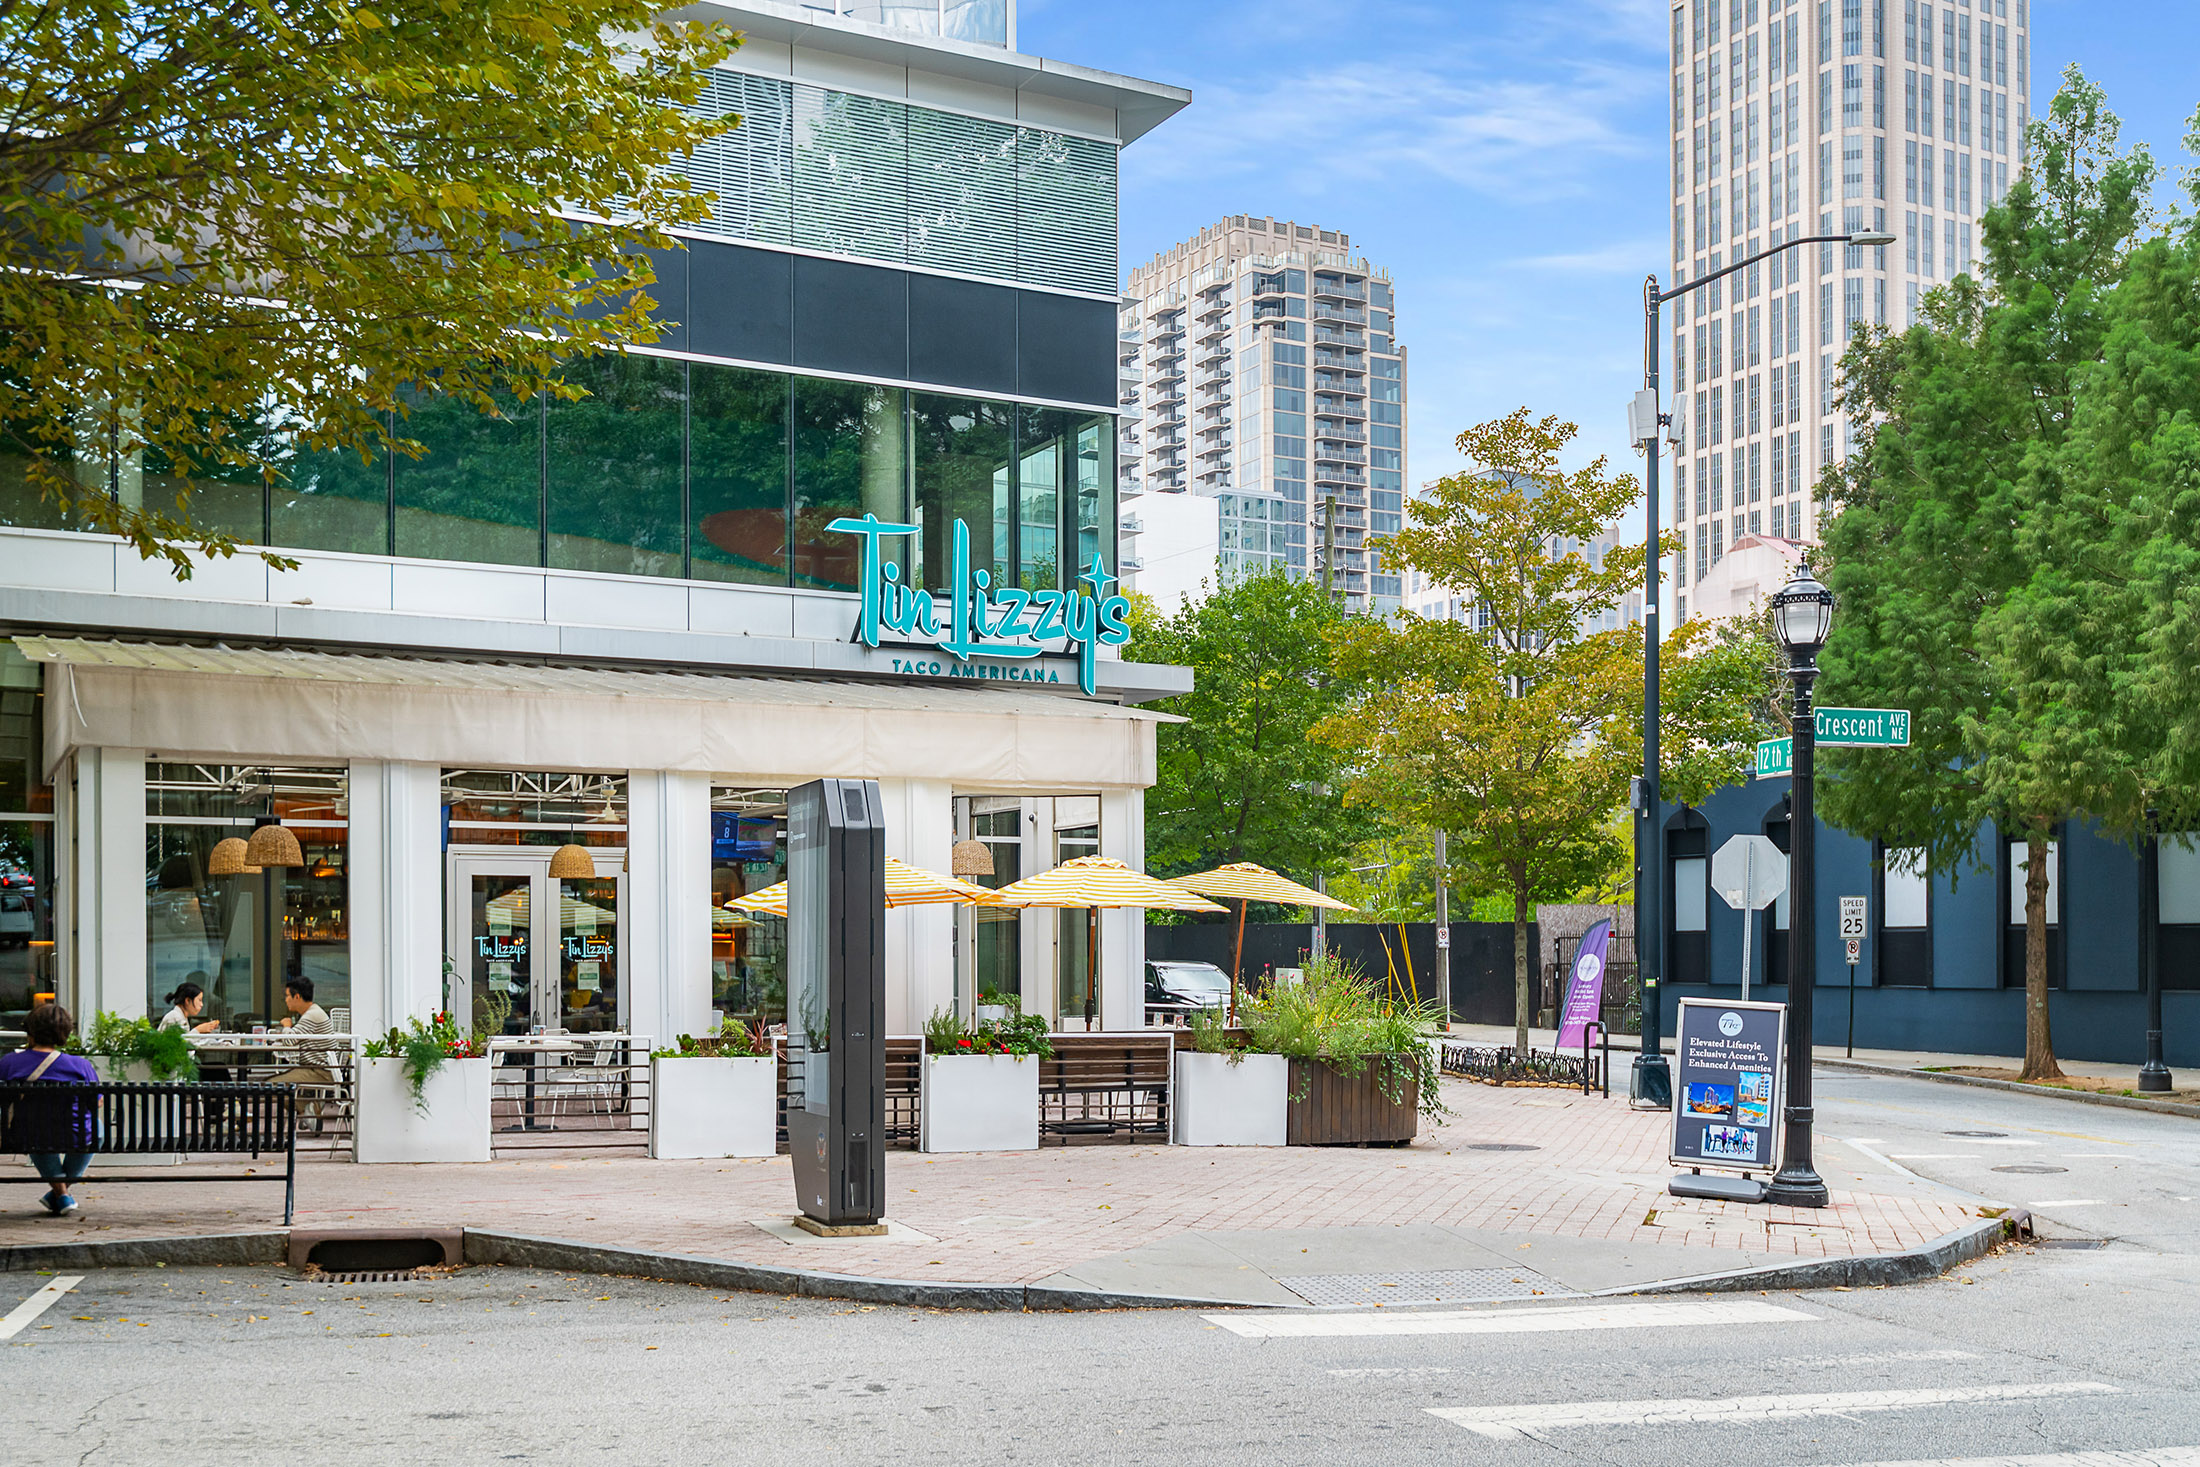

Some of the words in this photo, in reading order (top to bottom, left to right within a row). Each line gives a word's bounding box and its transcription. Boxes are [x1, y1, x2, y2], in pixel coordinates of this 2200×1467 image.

[824, 512, 941, 648] Tin
[893, 659, 942, 675] TACO
[950, 663, 1060, 683] AMERICANA
[1816, 712, 1883, 737] Crescent
[1889, 713, 1906, 727] AVE
[1891, 727, 1904, 740] NE
[1760, 747, 1769, 770] 12
[1843, 899, 1864, 907] SPEED
[1845, 908, 1862, 916] LIMIT
[1844, 918, 1863, 934] 25
[474, 935, 494, 958] Tin
[563, 936, 582, 958] Tin
[1690, 1037, 1724, 1048] Elevated
[1726, 1040, 1762, 1052] Lifestyle
[1689, 1048, 1727, 1059] Exclusive
[1728, 1051, 1756, 1061] Access
[1757, 1052, 1769, 1062] To
[1688, 1059, 1729, 1070] Enhanced
[1730, 1062, 1772, 1073] Amenities
